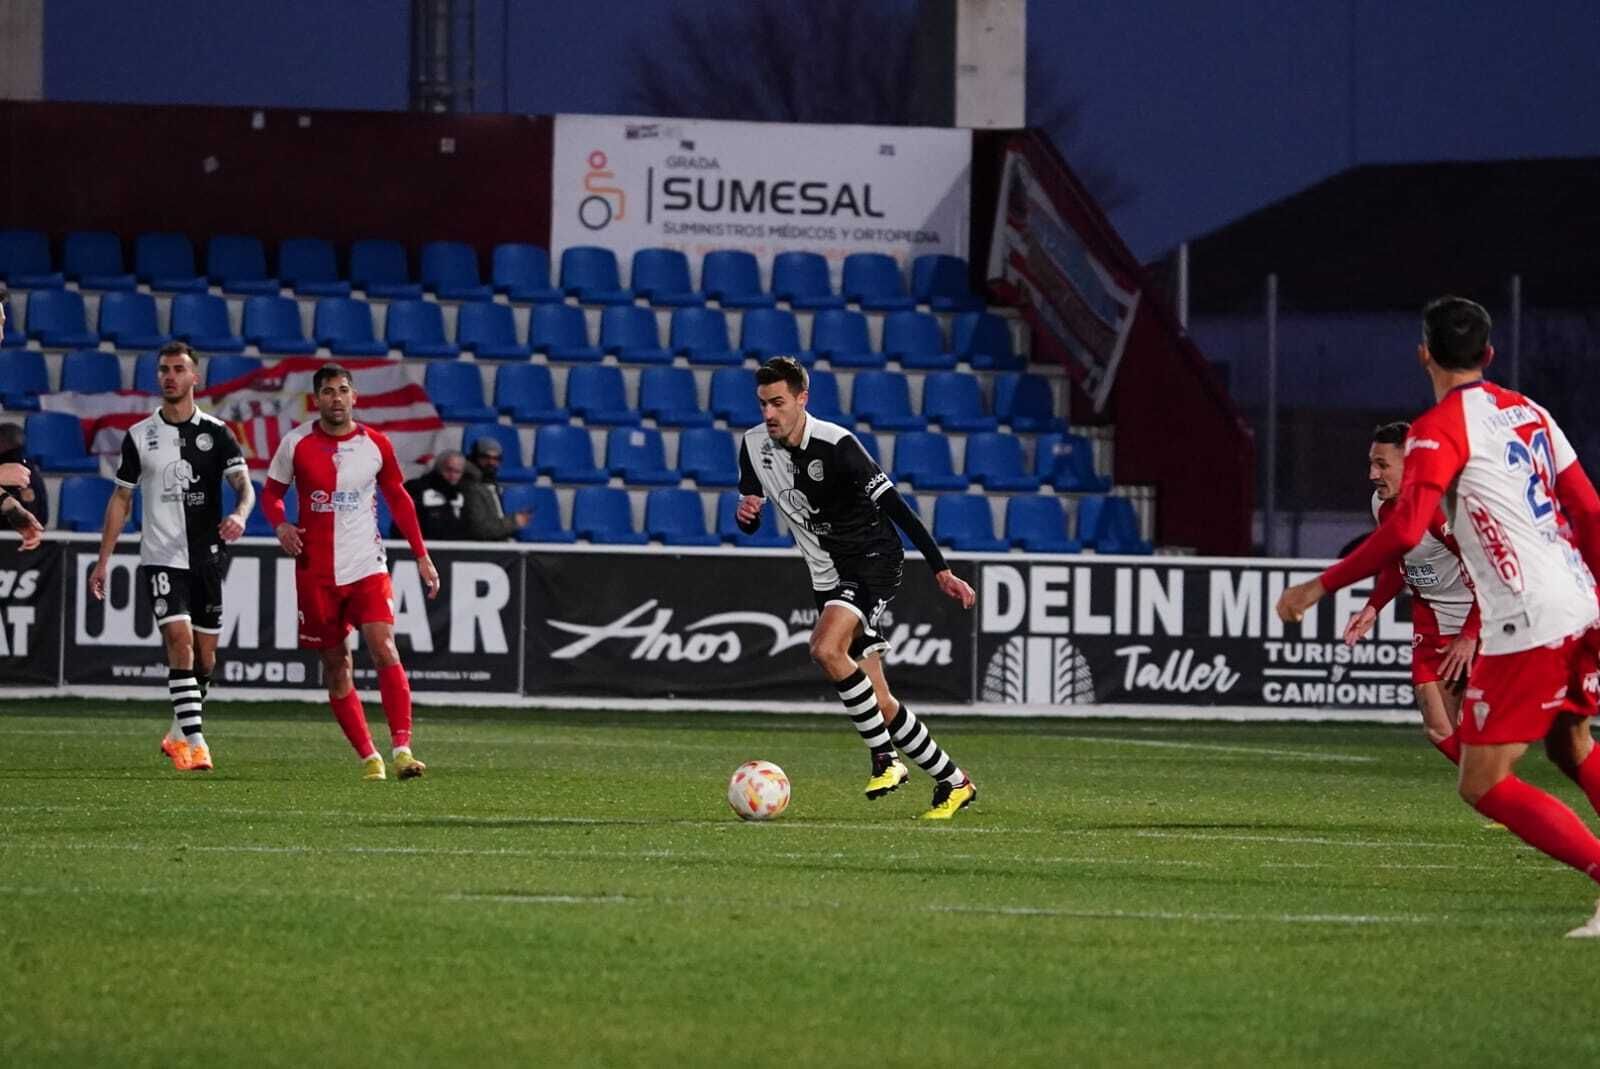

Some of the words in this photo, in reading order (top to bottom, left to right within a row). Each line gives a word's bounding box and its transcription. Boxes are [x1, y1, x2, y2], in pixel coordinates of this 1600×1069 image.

[665, 155, 720, 170] GRADA
[662, 177, 885, 218] SUMESAL
[662, 222, 766, 238] SUMINISTROS
[768, 223, 838, 240] MÉDICOS
[841, 227, 851, 239] Y
[853, 228, 941, 244] ORTOPEDIA
[1504, 428, 1556, 526] 21
[1471, 507, 1518, 581] ZPMC
[150, 571, 171, 597] 18
[980, 564, 1185, 636] DELIN
[1114, 644, 1241, 694] Taller
[1264, 641, 1414, 665] TURISMOS
[1262, 681, 1415, 705] CAMIONES
